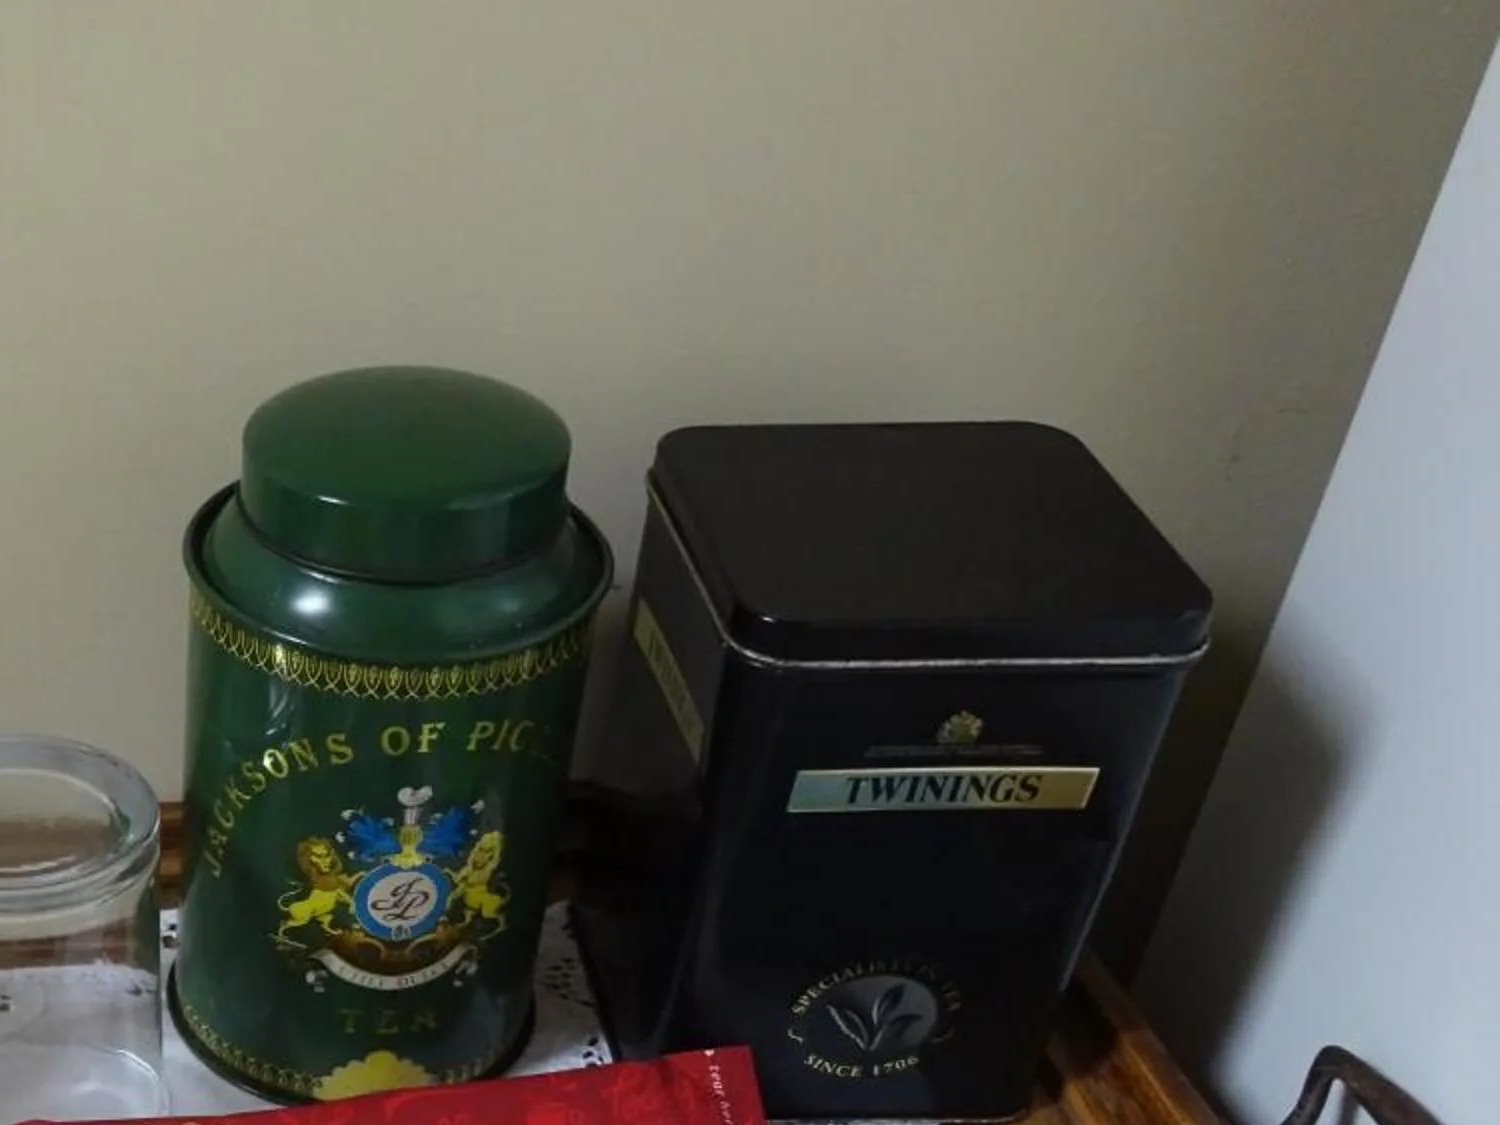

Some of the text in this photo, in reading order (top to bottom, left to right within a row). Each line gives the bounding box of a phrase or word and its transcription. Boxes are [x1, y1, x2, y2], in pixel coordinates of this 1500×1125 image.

[203, 719, 537, 878] JACKSONS OF PIC
[845, 773, 1044, 805] TWININGS
[803, 1053, 920, 1078] SINCE 1706
